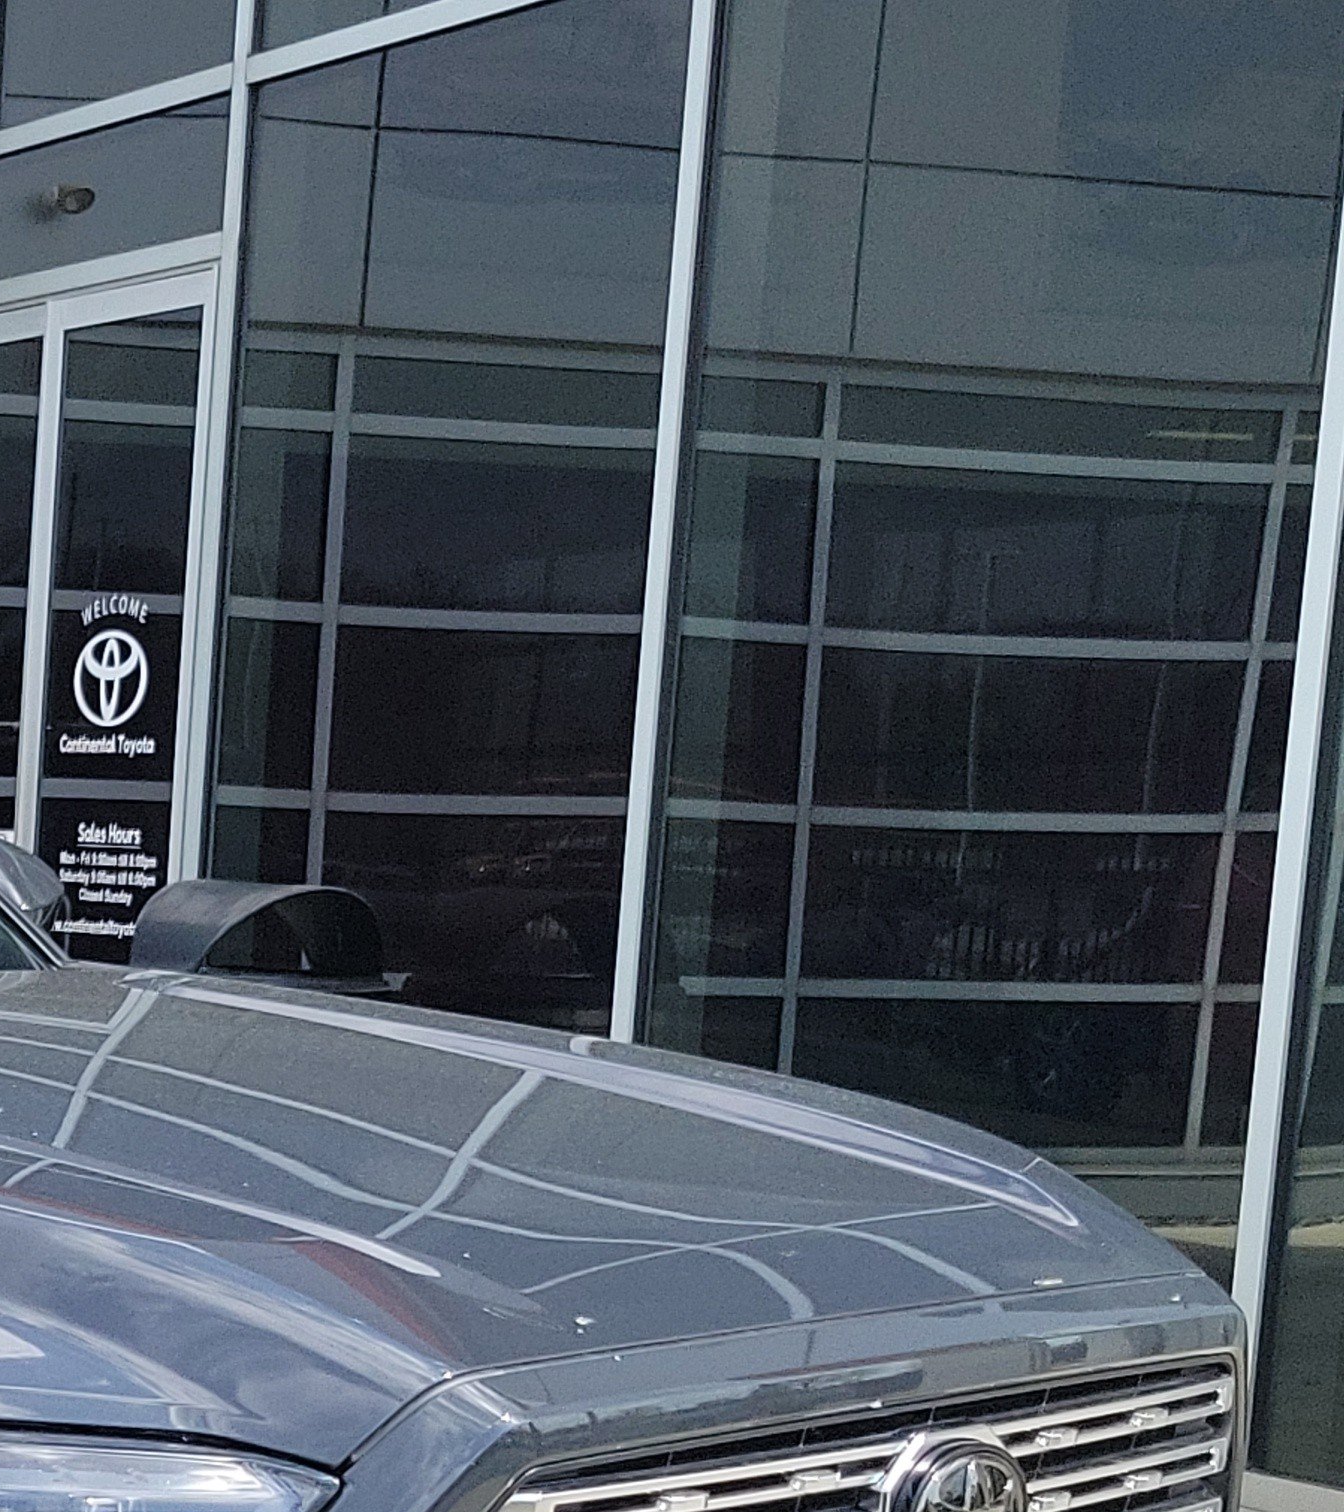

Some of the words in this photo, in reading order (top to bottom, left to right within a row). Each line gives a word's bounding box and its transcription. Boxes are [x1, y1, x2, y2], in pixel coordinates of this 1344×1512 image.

[81, 593, 148, 627] WELCOME
[59, 733, 116, 754] Continental
[117, 733, 155, 758] Toyota
[77, 821, 107, 844] Sales
[107, 822, 142, 845] Hours
